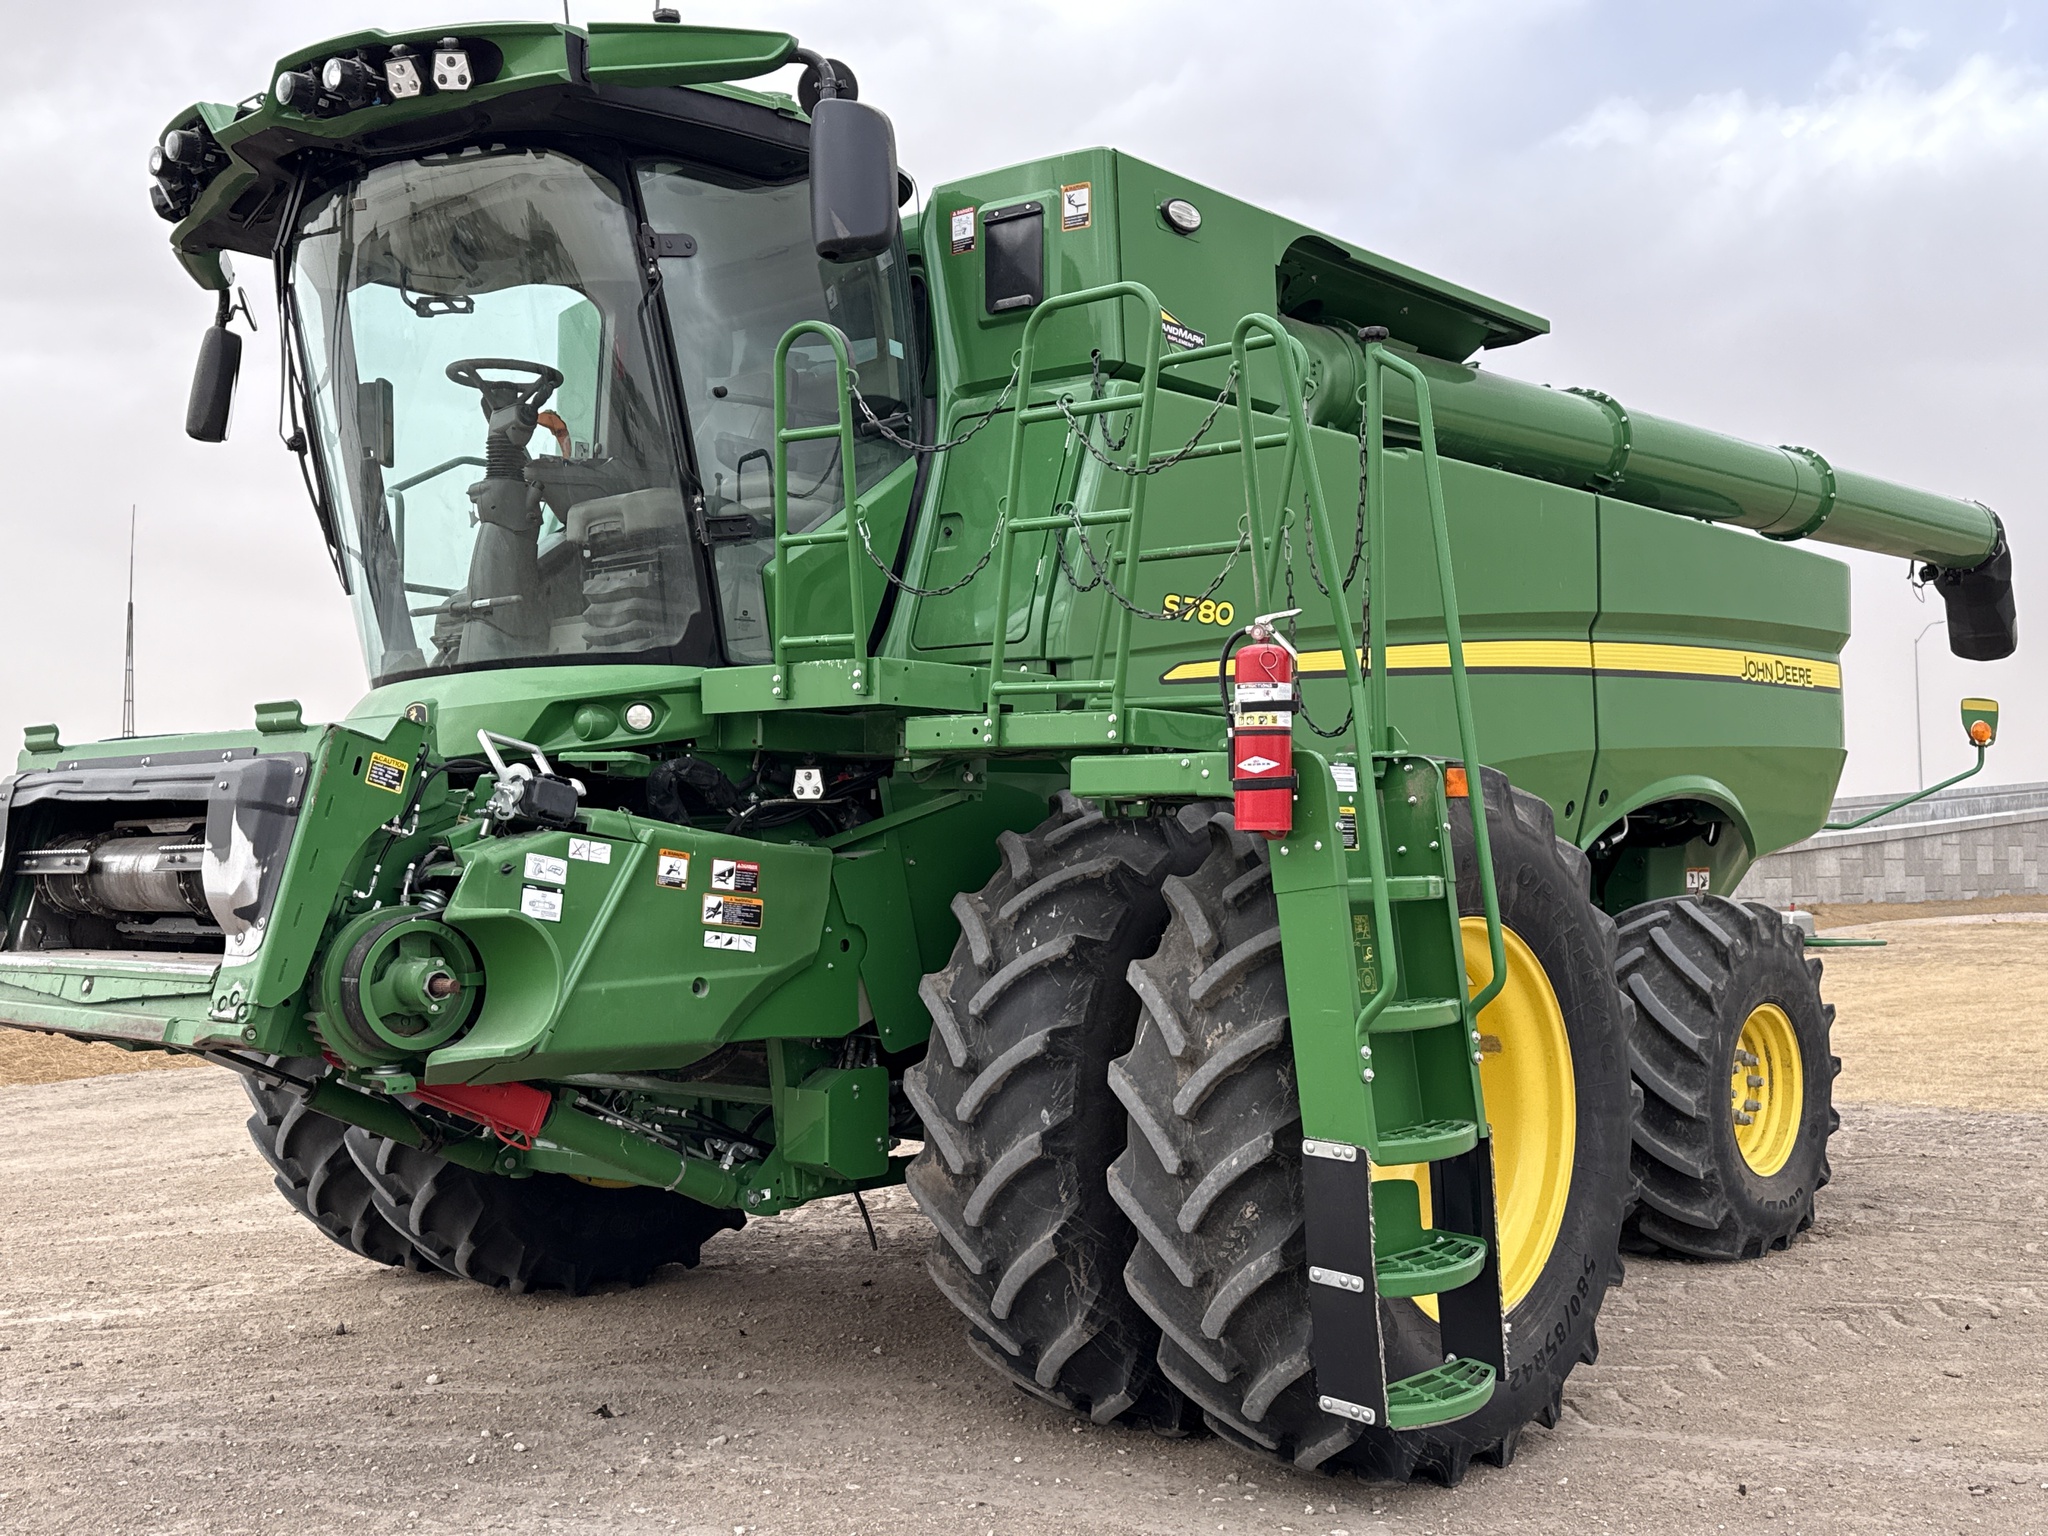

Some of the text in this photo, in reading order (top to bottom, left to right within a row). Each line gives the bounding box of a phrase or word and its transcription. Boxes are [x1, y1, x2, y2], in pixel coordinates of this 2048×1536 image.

[1162, 323, 1205, 346] ANDMARK
[1162, 593, 1235, 627] S780
[1741, 655, 1813, 685] JOHN DEERE
[379, 755, 407, 770] CAUTION
